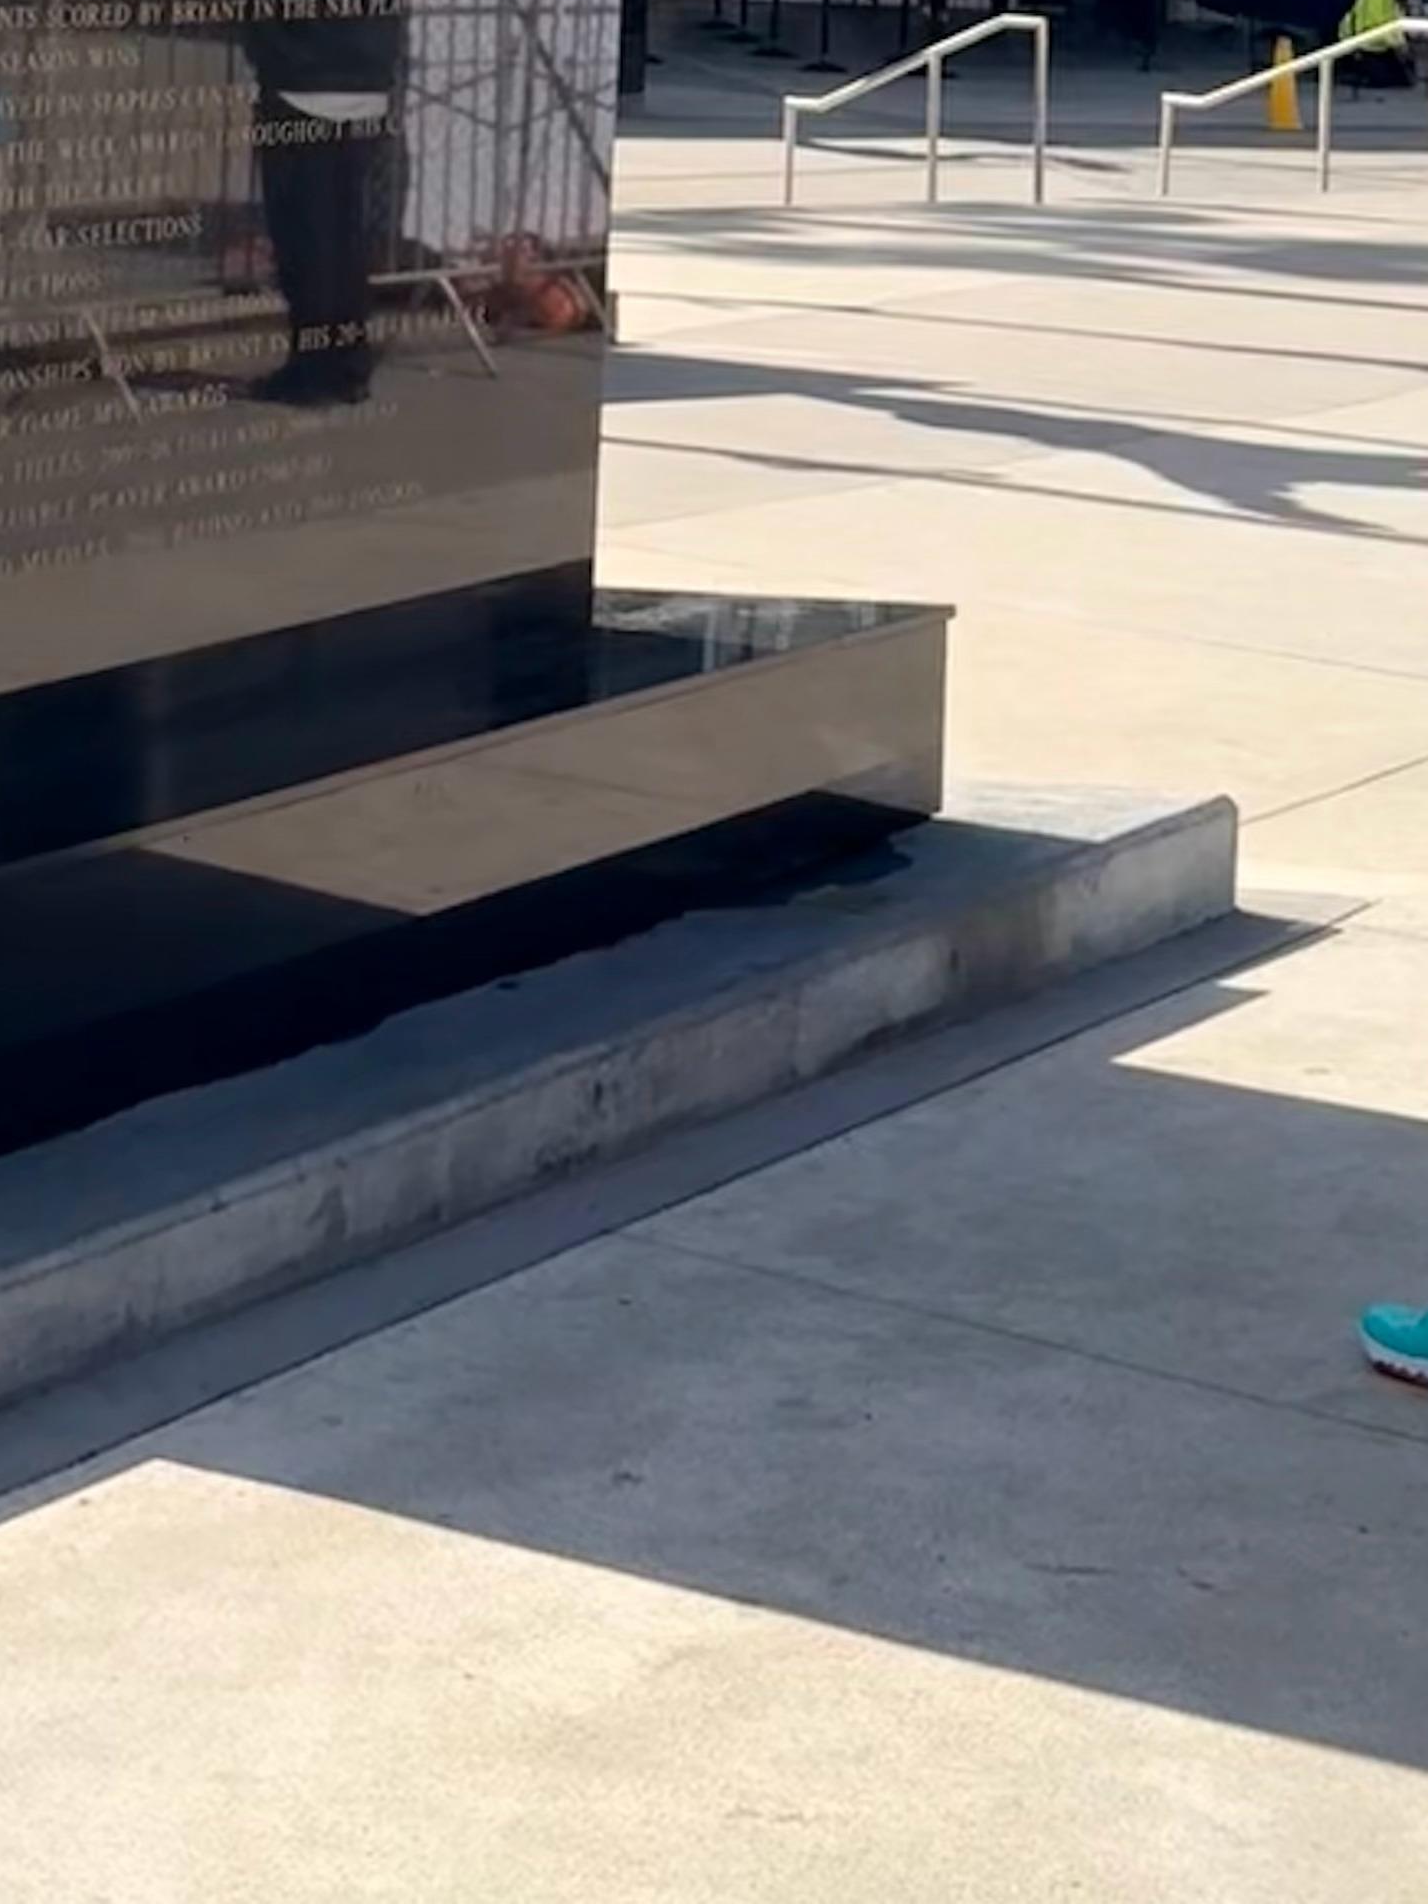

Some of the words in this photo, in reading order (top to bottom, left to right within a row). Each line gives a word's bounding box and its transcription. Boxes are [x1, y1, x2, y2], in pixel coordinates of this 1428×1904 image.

[45, 1, 132, 28] SCORED
[137, 3, 169, 26] BY
[0, 47, 76, 72] SEASON
[87, 44, 140, 68] WINS
[76, 210, 203, 248] SELECTIONS
[297, 322, 330, 352] HIS
